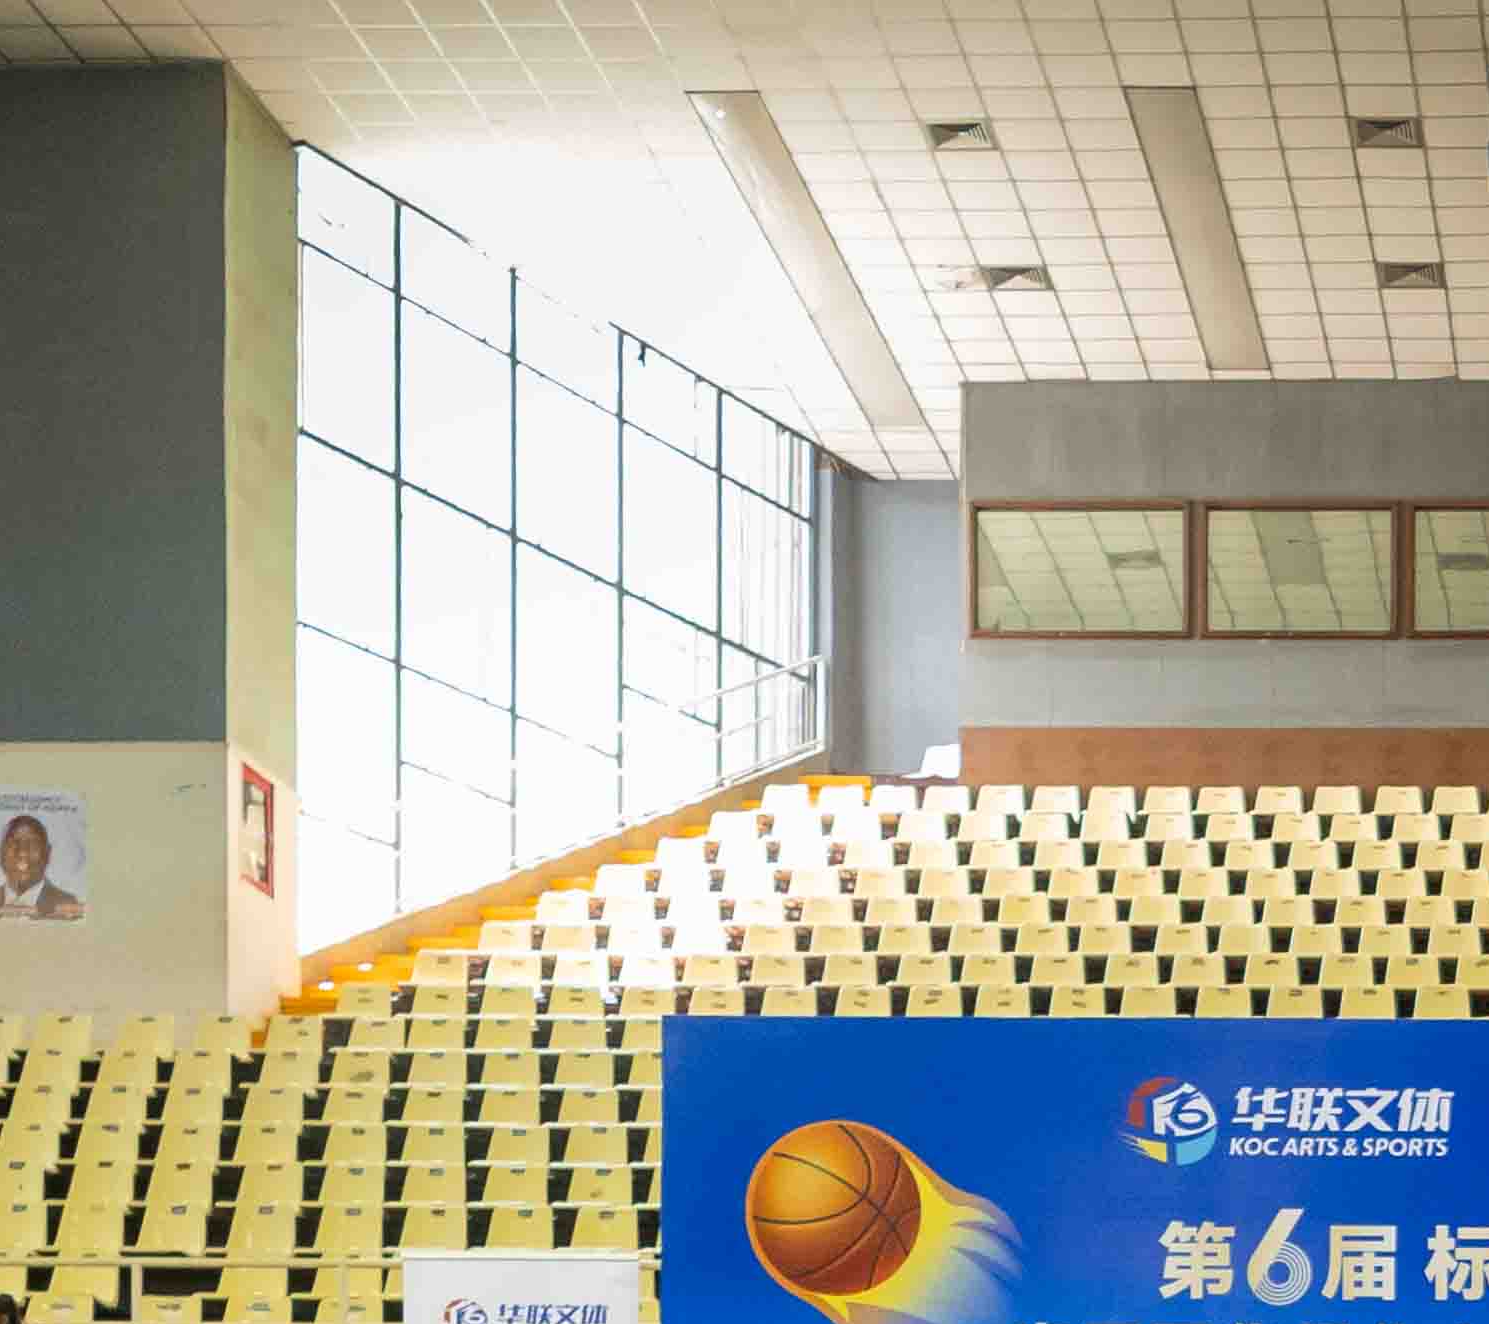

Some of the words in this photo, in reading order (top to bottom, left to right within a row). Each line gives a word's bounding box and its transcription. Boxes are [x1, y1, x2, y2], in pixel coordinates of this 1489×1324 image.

[1230, 1087, 1455, 1132] 华联文体
[1229, 1137, 1281, 1157] KOC
[1283, 1137, 1338, 1157] ARTS
[1342, 1138, 1358, 1157] &
[1362, 1138, 1449, 1157] SPORTS
